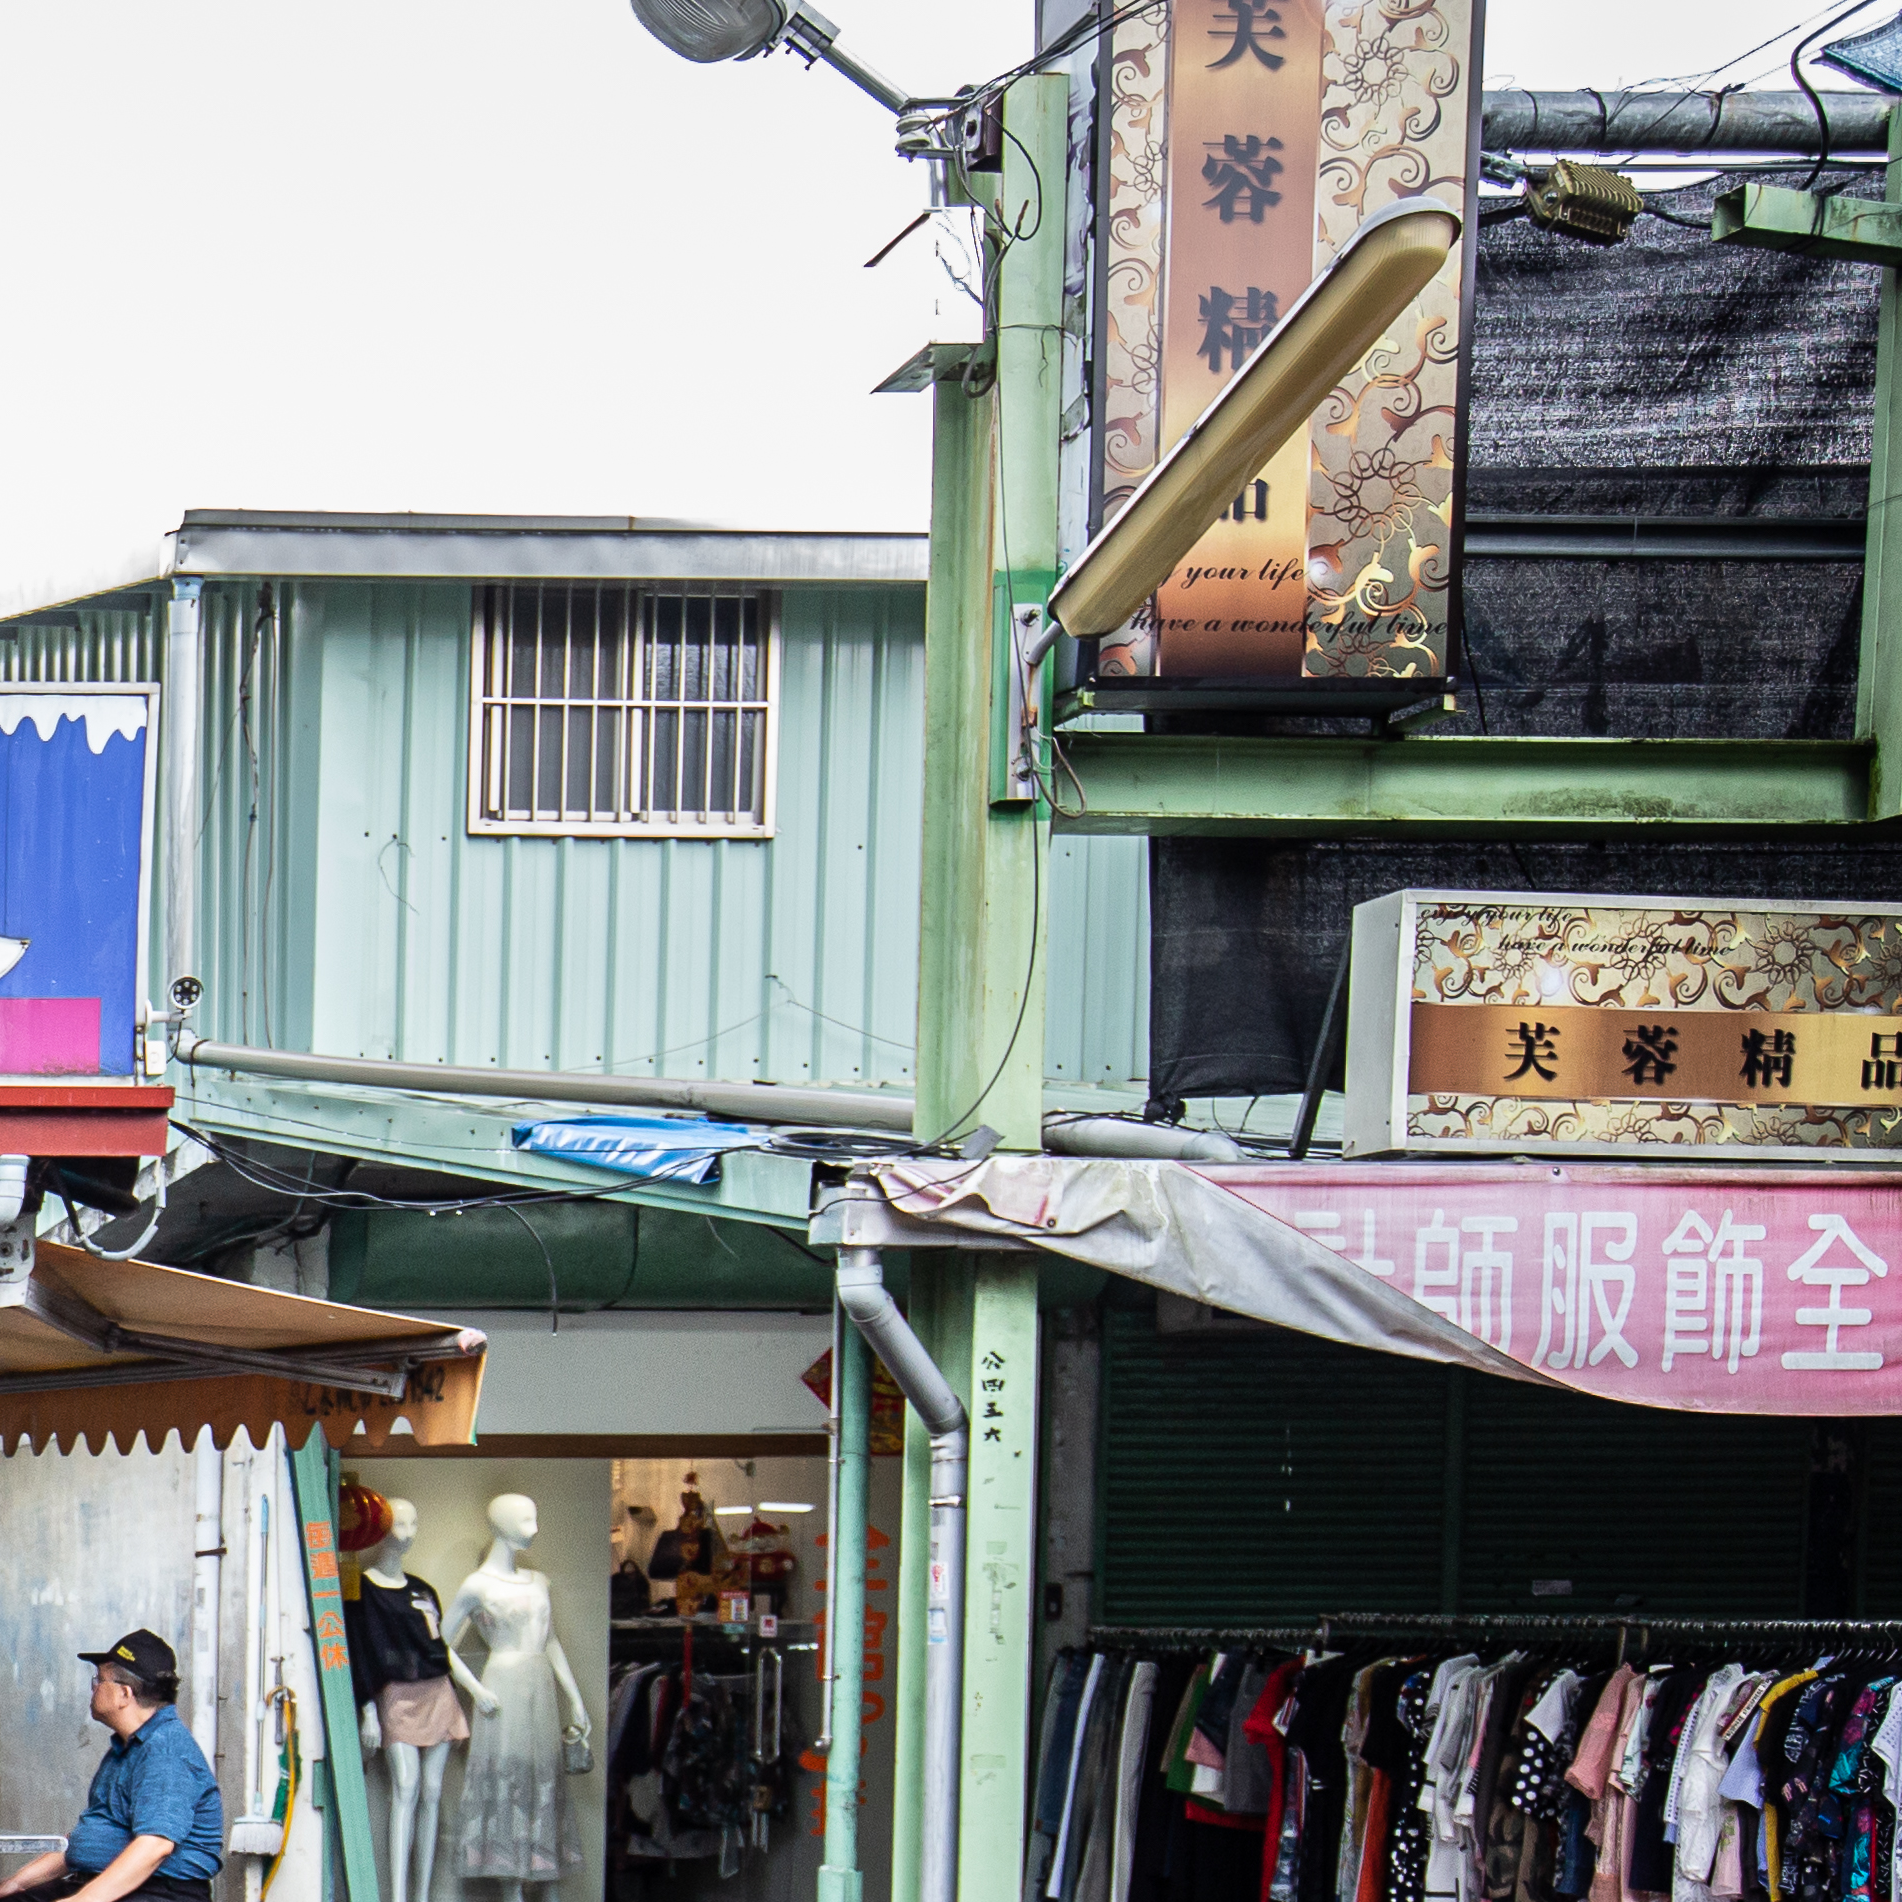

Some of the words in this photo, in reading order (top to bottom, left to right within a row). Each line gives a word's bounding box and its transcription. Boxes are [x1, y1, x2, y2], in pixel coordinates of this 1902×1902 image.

[1181, 564, 1252, 590] your
[1258, 558, 1307, 591] life
[1130, 609, 1197, 634] have
[1230, 612, 1380, 645] wonderful
[1503, 1020, 1902, 1090] 芙蓉精品
